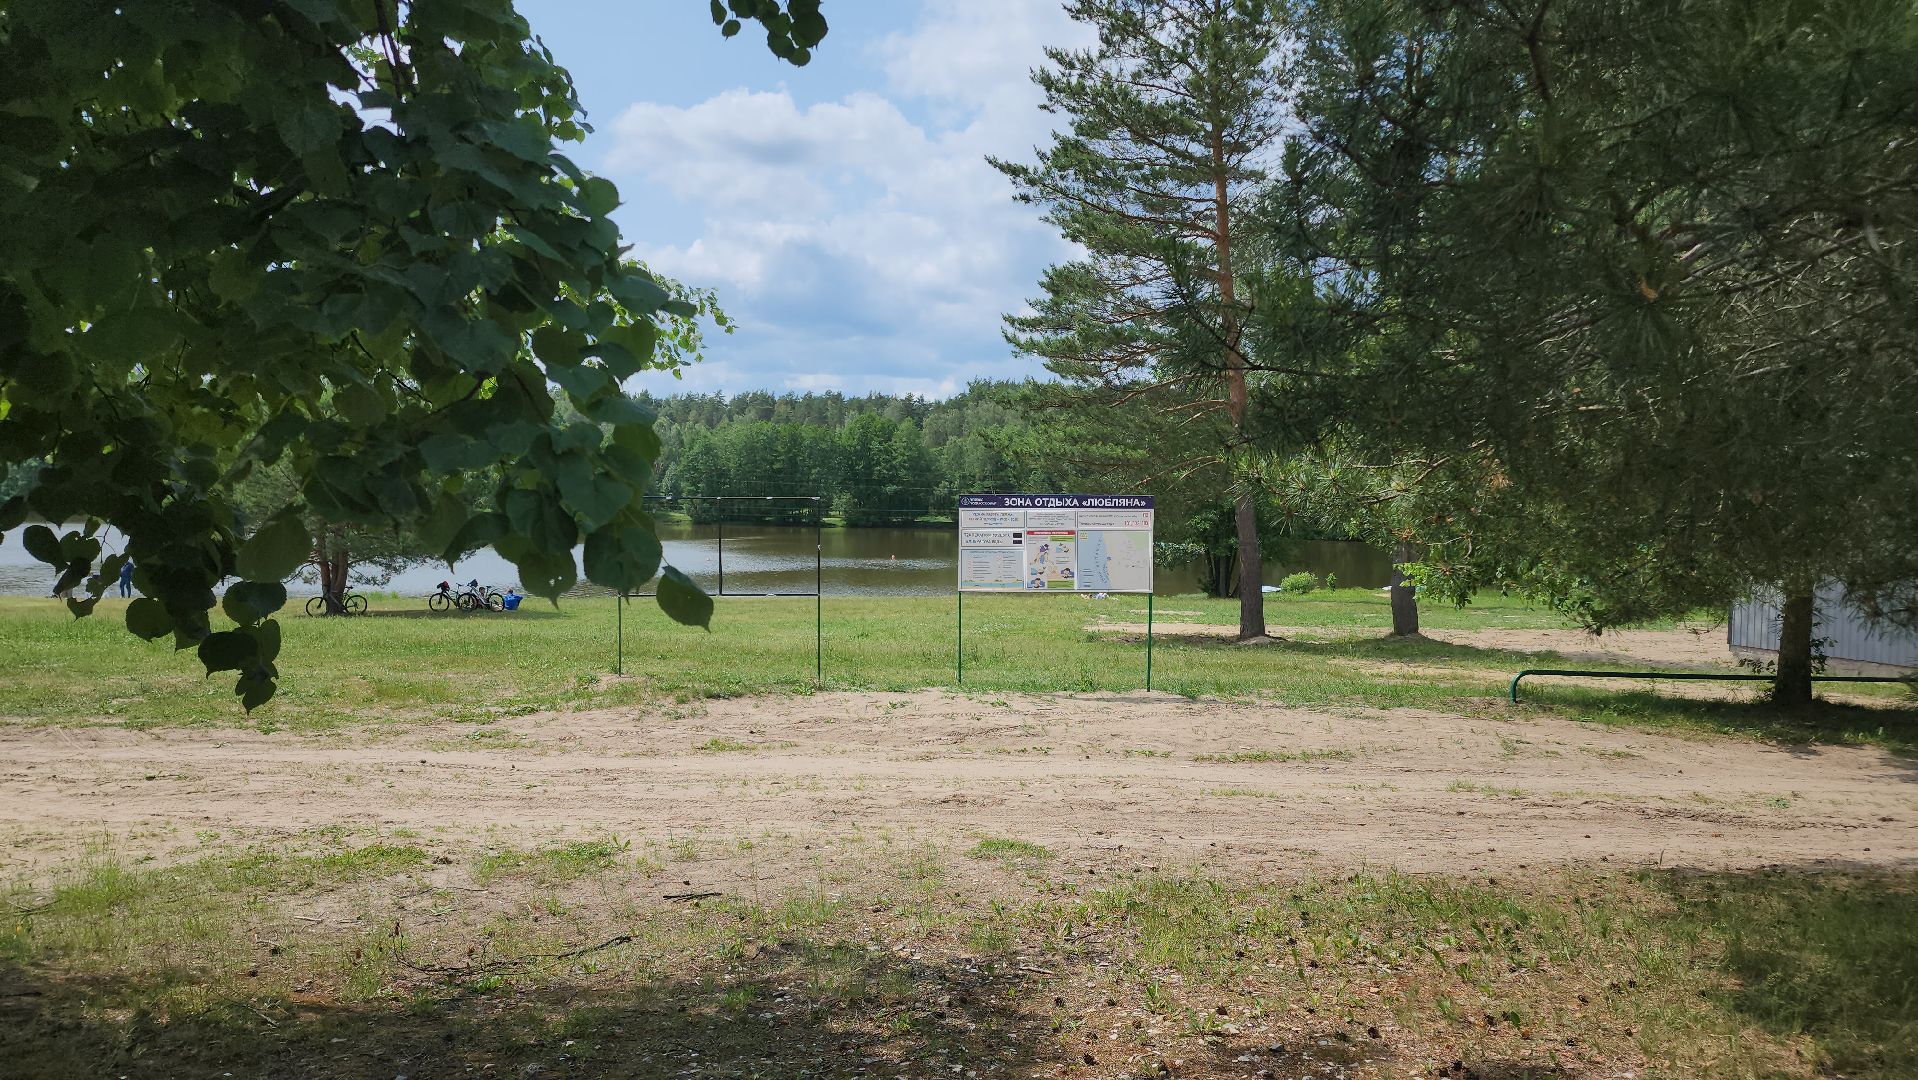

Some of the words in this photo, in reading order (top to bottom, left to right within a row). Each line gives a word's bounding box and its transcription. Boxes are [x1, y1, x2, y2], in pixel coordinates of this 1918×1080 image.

[1004, 498, 1032, 507] ЗОНА
[1035, 498, 1079, 508] ОТДЫХА
[1082, 498, 1146, 507] «ЛЮБЛЯНА»
